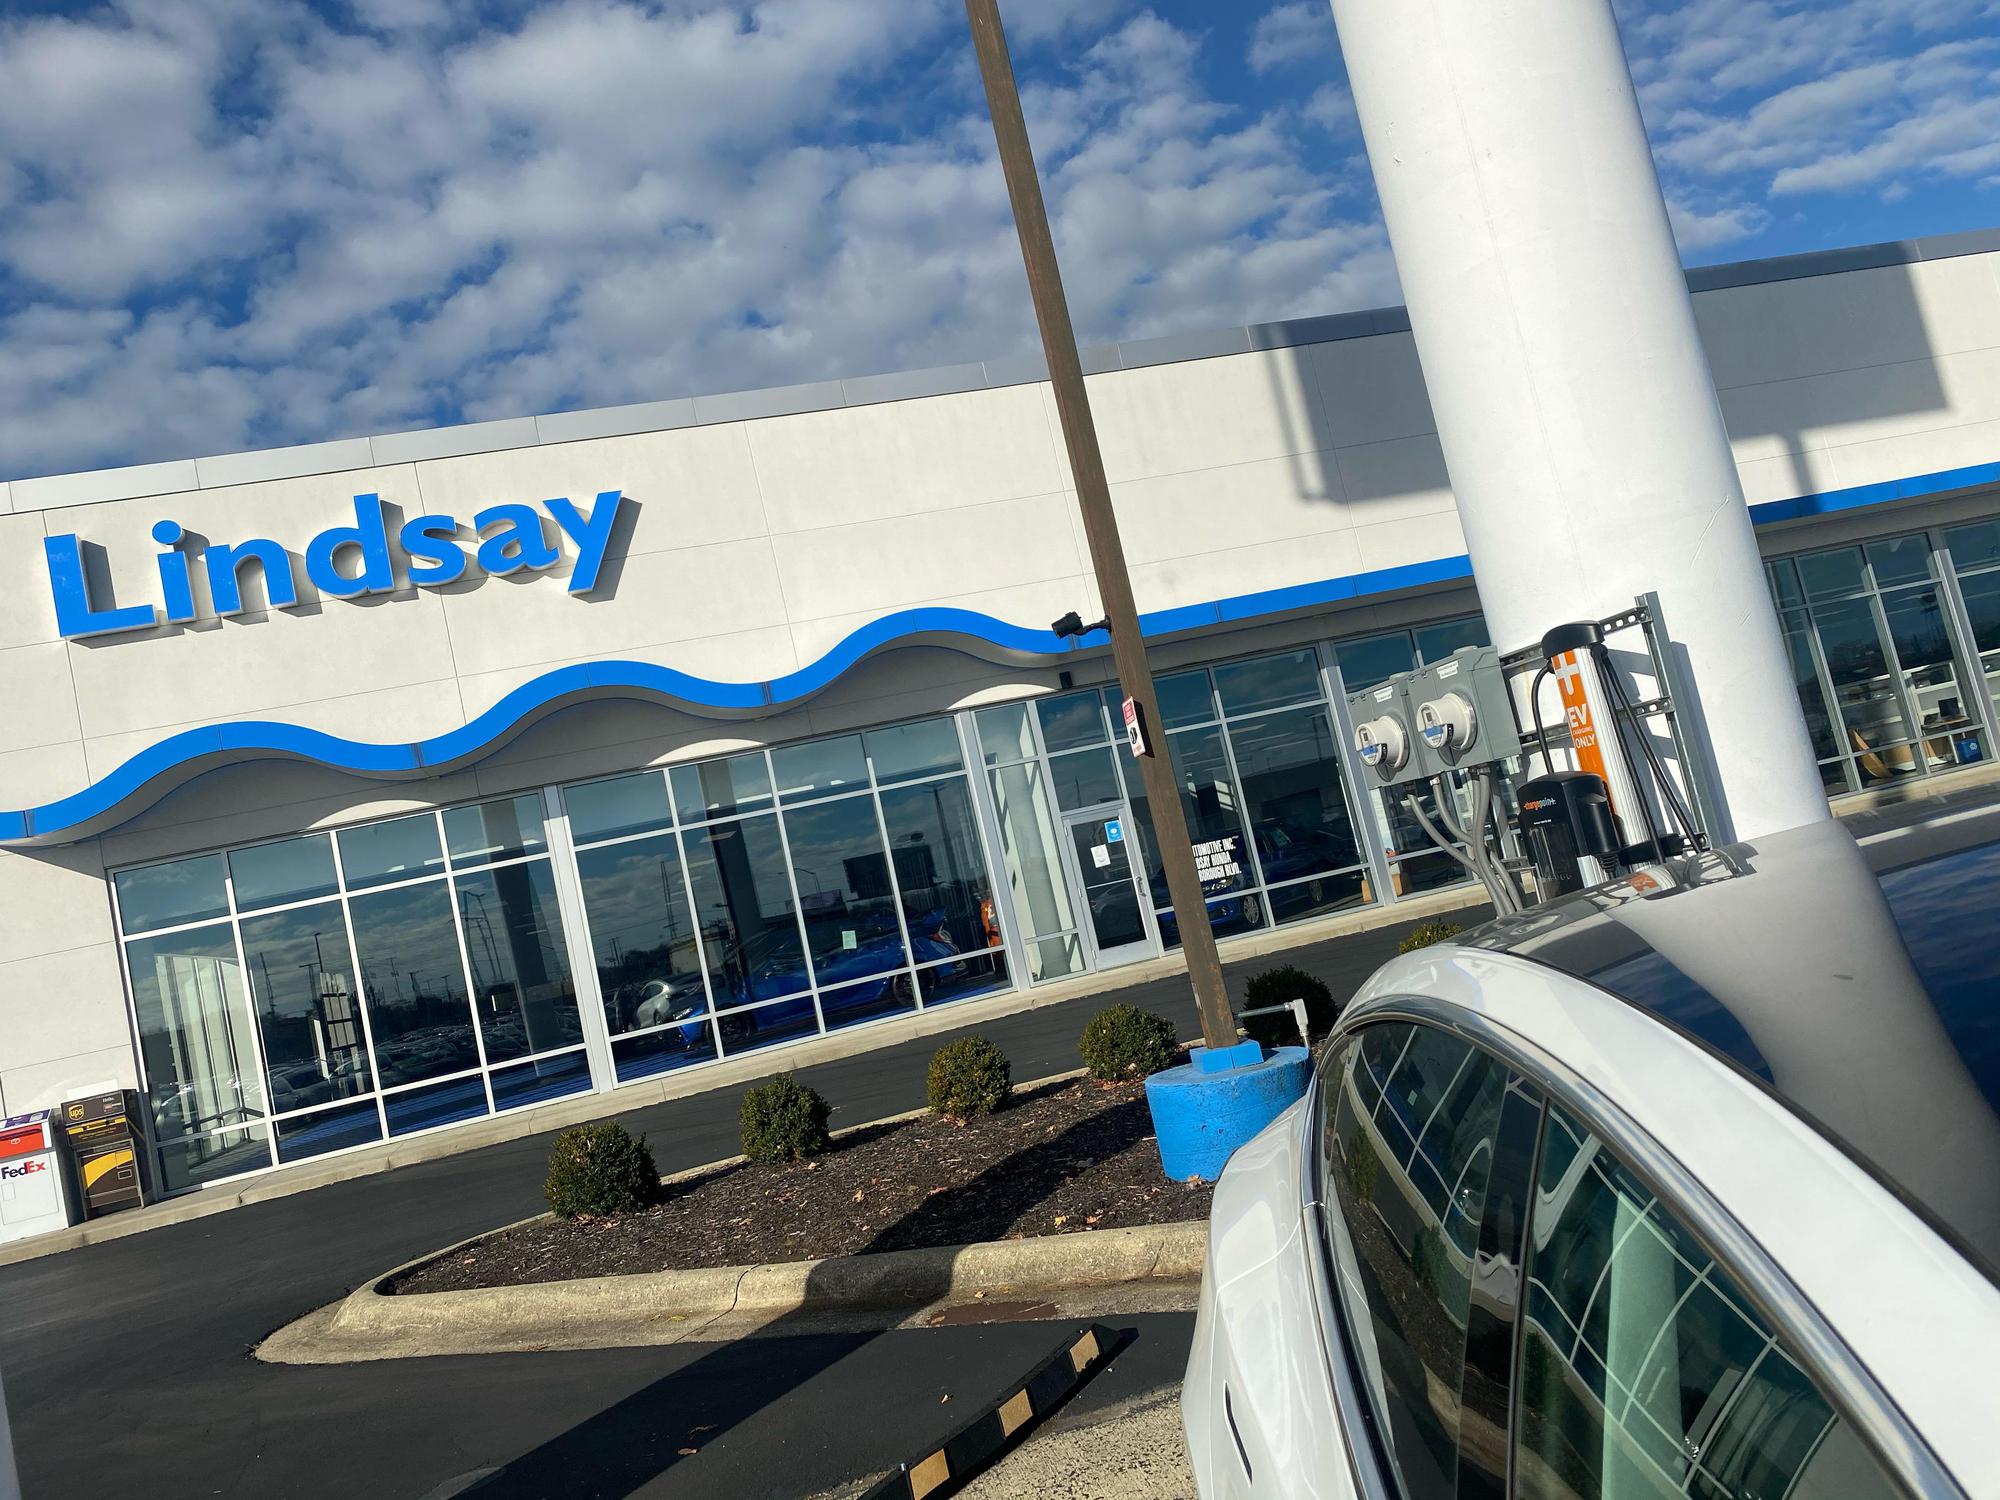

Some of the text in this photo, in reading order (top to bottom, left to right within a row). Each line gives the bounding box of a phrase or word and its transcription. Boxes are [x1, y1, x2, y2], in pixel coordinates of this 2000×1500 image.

[44, 490, 622, 639] Lindsay
[1567, 704, 1587, 728] EV
[1575, 734, 1595, 749] ONLY
[1195, 851, 1232, 870] DSAY HONDA
[1197, 862, 1242, 882] BOROUGH BLVD.
[1, 1161, 46, 1179] FedEx
